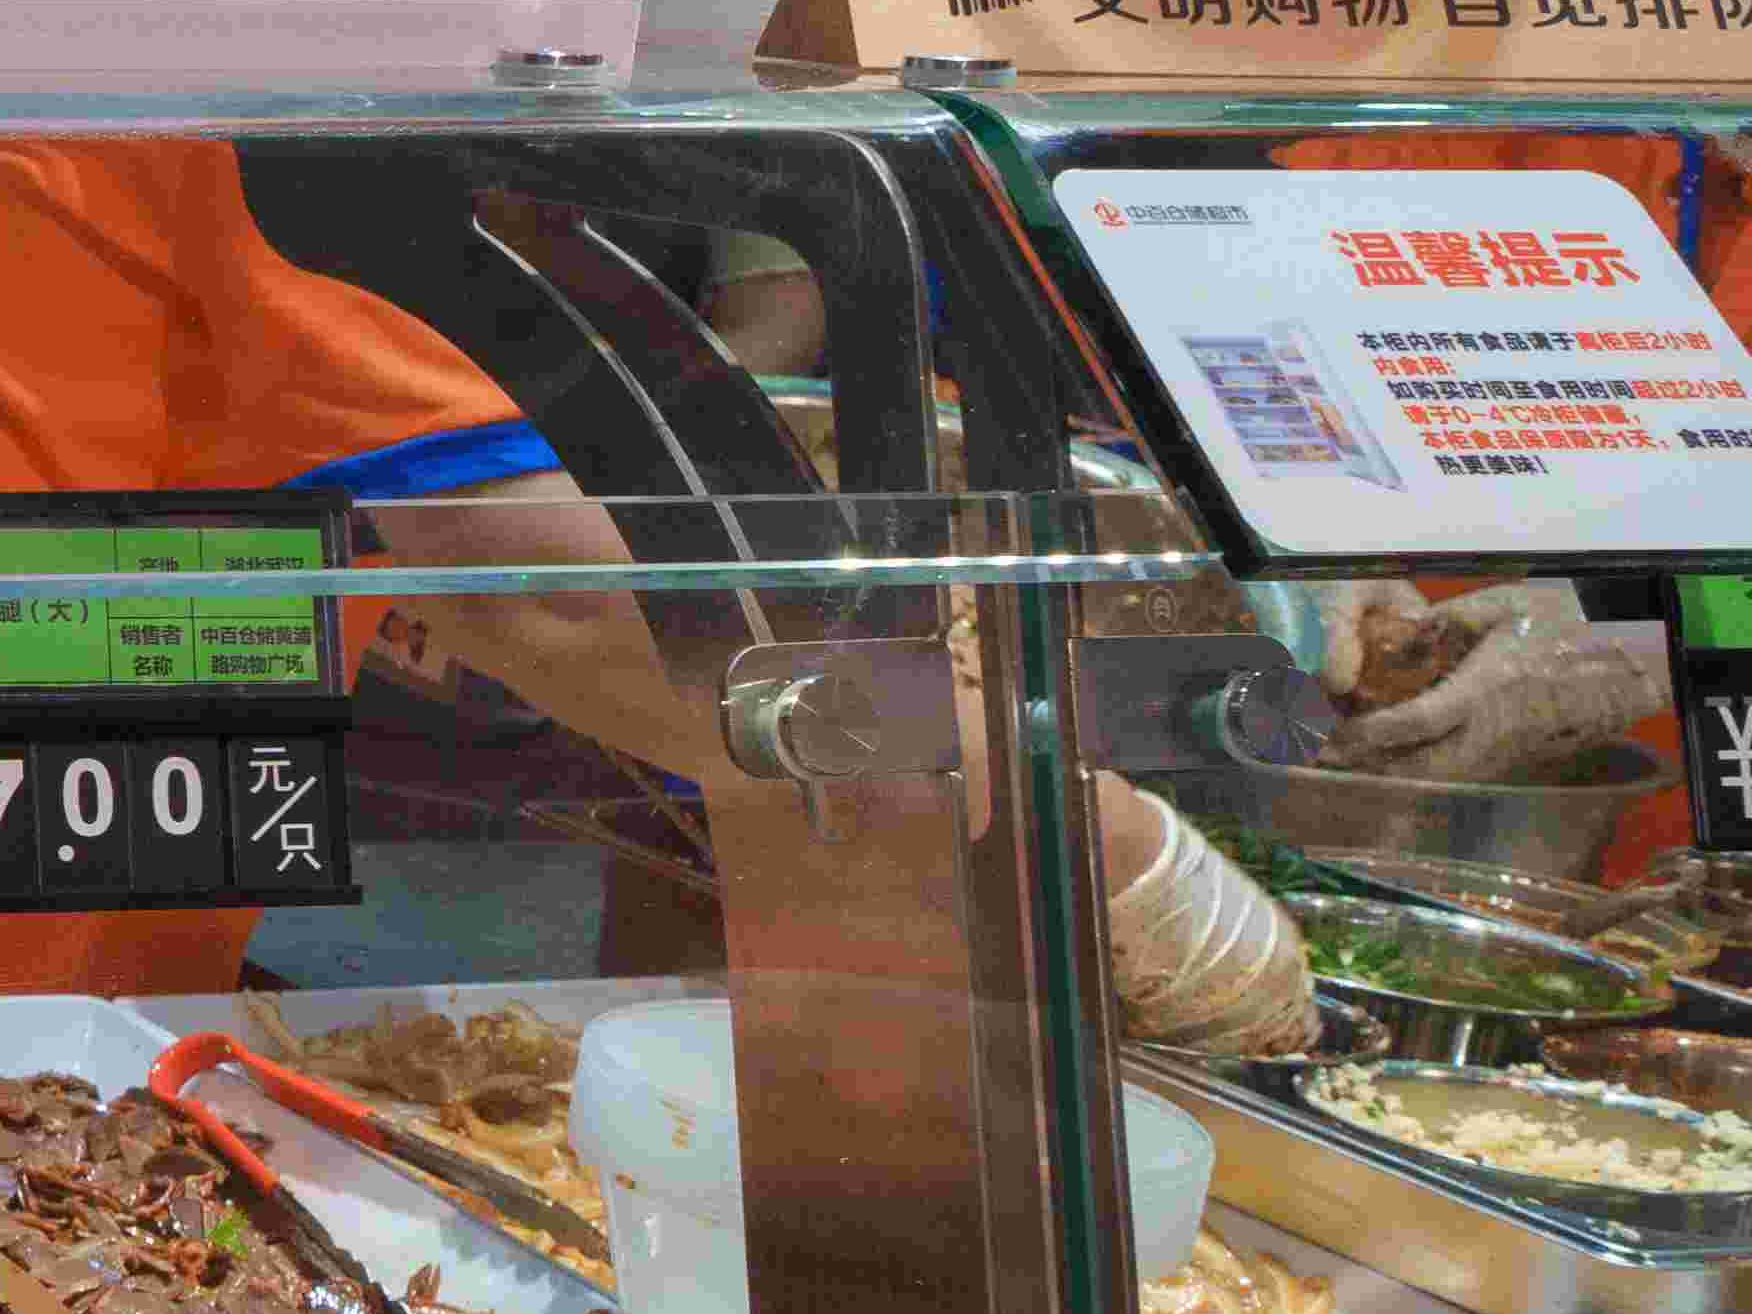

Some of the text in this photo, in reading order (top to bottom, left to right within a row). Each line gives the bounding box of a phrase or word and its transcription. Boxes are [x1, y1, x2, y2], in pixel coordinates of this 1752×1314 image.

[1332, 230, 1641, 287] 温馨提示
[134, 654, 173, 676] 名称
